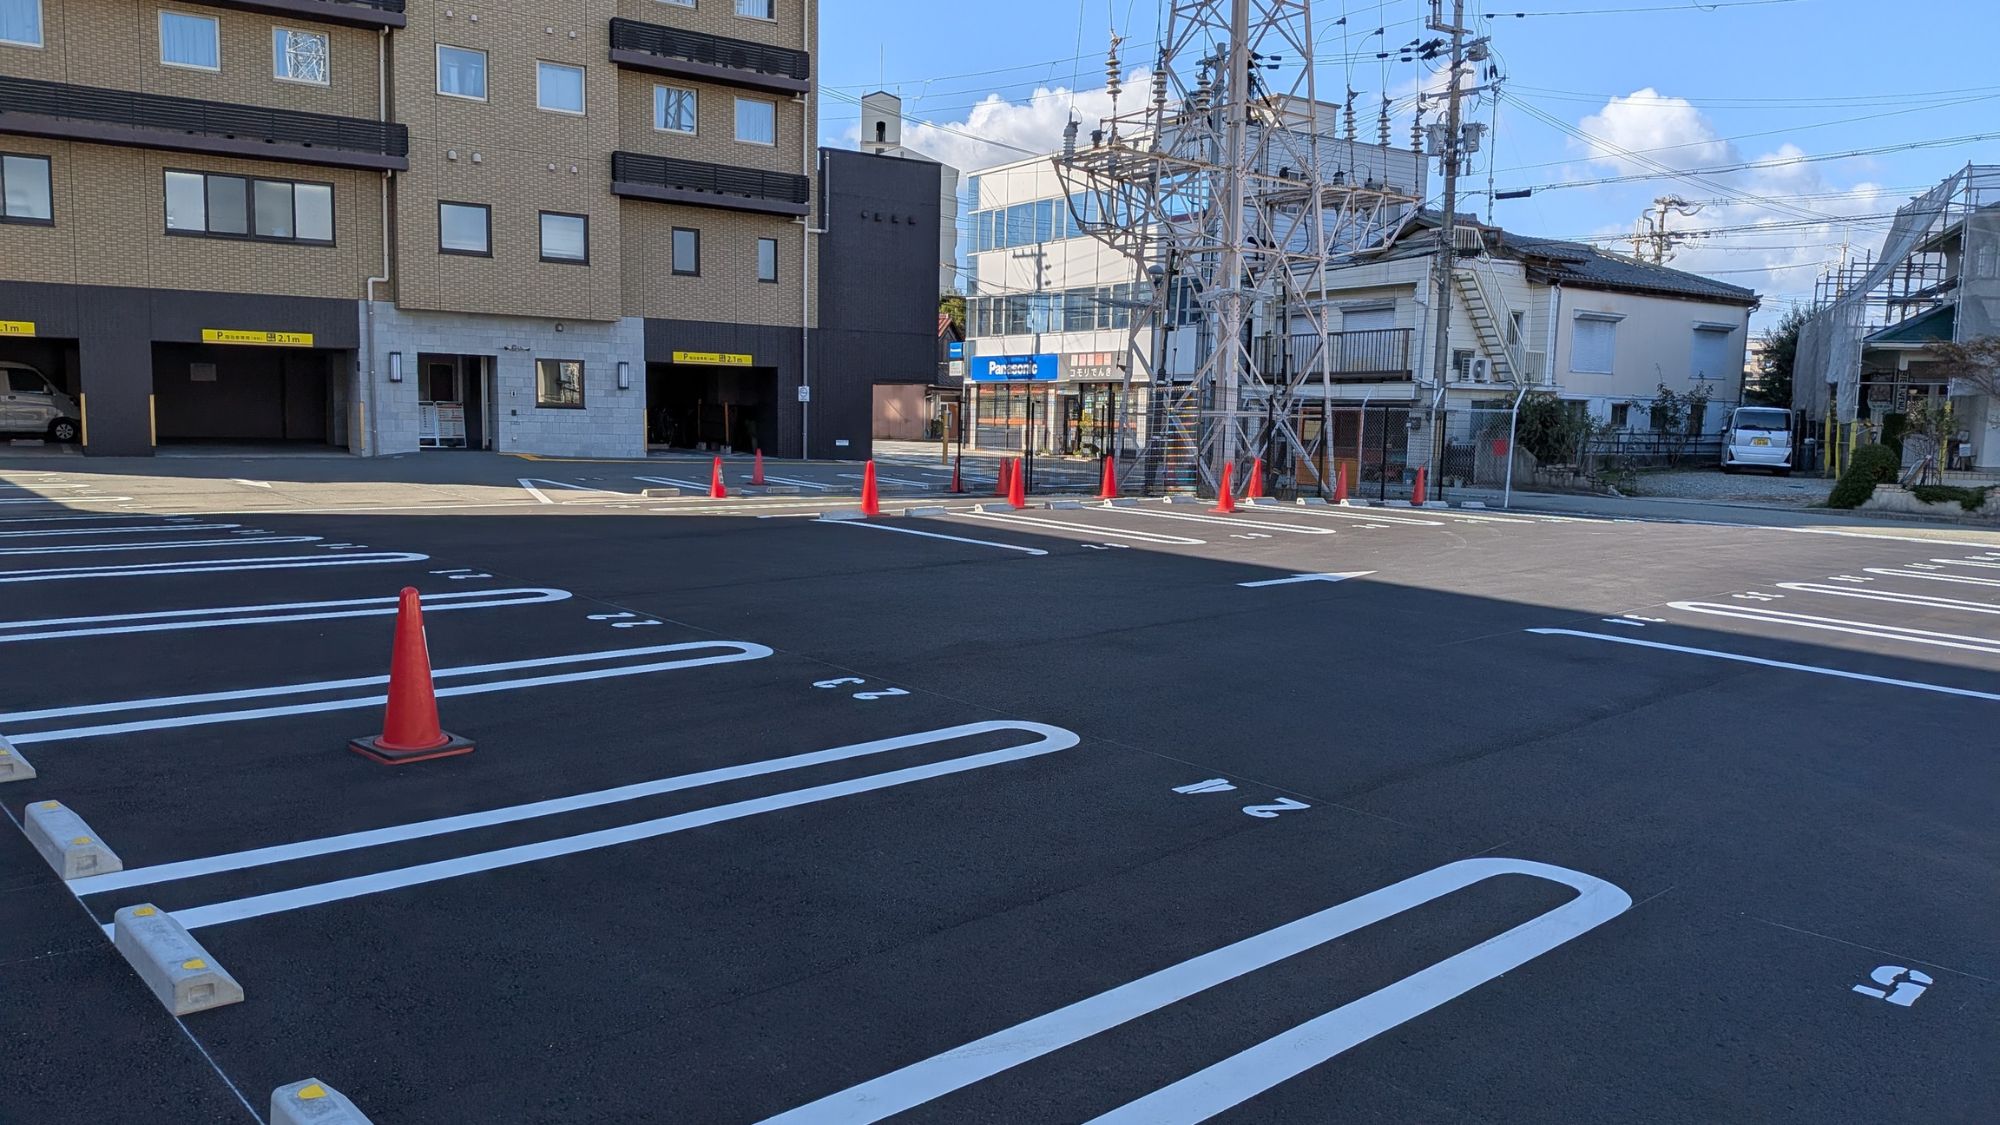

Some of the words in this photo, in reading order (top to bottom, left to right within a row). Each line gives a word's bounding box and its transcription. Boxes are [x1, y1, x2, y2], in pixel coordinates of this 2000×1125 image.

[216, 331, 224, 340] P
[278, 334, 300, 343] 2.1m
[683, 353, 689, 361] P
[726, 355, 743, 363] 2.1m
[988, 359, 1038, 376] Panasonic
[586, 612, 663, 628] 22
[812, 677, 911, 700] 23
[1171, 778, 1310, 816] 24
[1852, 965, 1934, 1007] 5
